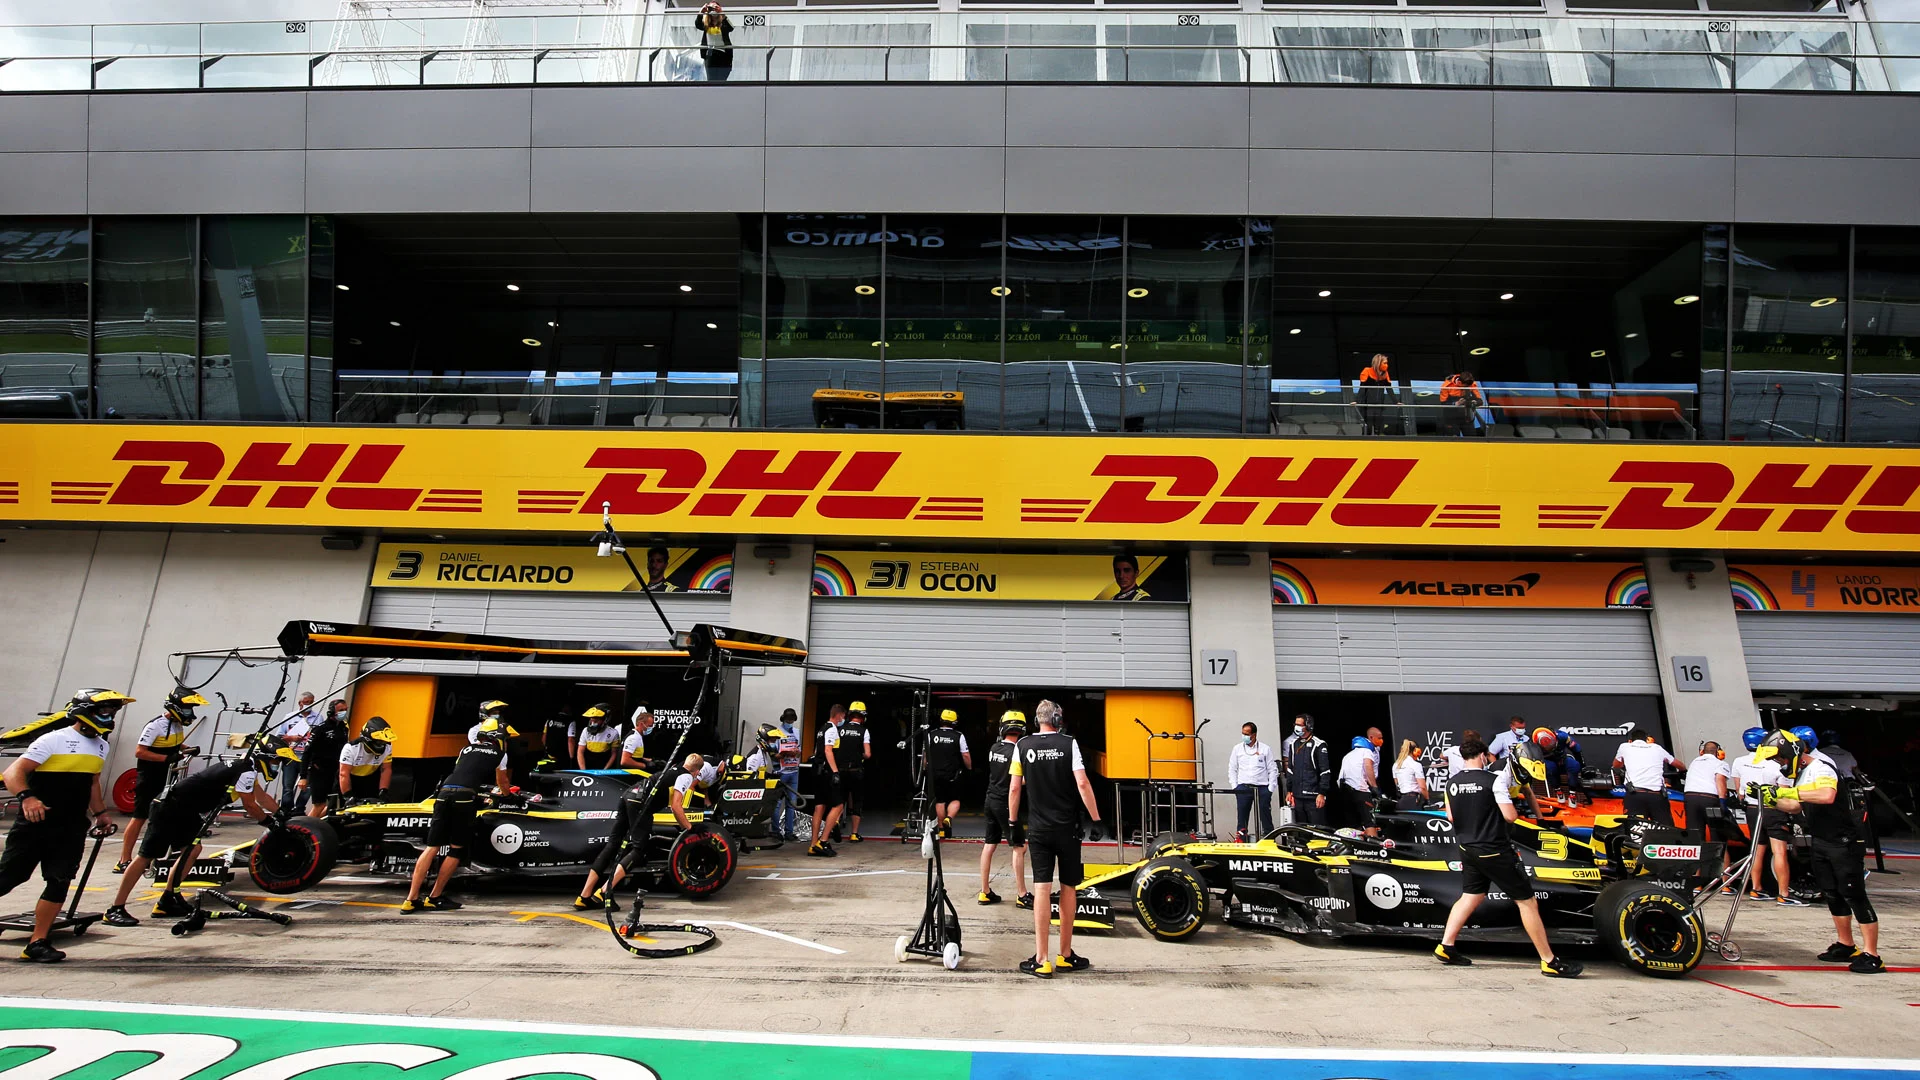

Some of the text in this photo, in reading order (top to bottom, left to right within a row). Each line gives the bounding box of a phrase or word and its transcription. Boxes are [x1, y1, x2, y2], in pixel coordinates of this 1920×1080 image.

[106, 440, 423, 511] DHL
[577, 447, 921, 520] DHL
[1084, 455, 1438, 528] DHL
[1600, 461, 1920, 534] DHL
[439, 552, 483, 562] DANIEL
[388, 550, 424, 580] 3
[920, 561, 979, 572] ESTEBAN
[436, 563, 574, 584] RICCIARDO
[865, 560, 911, 590] 31
[1836, 575, 1881, 585] LANDO
[920, 572, 997, 593] OCON
[1380, 576, 1534, 597] McLaren
[1791, 570, 1816, 608] 4
[1840, 586, 1920, 606] NORR
[1207, 658, 1229, 675] 17
[1680, 665, 1703, 682] 16
[653, 715, 701, 724] DP WORD
[1558, 725, 1632, 735] McLaren
[1427, 731, 1453, 747] WE
[733, 790, 762, 800] Castrol
[386, 817, 432, 827] MAPF
[722, 816, 753, 827] yahoo!
[496, 832, 517, 844] RCi
[588, 836, 609, 844] E-TE
[1414, 836, 1456, 844] INFINI
[1536, 831, 1569, 861] 3
[1657, 846, 1698, 858] Castrol
[158, 865, 222, 876] RAULT
[1229, 859, 1293, 873] MAPFRE
[1648, 878, 1686, 889] hoo!
[1372, 884, 1396, 898] RCi
[1050, 903, 1109, 915] RAULT
[1314, 897, 1346, 910] DUPONT
[1640, 894, 1686, 911] ZERO
[1252, 905, 1278, 914] Microsoft
[1647, 960, 1683, 971] PIRELLI
